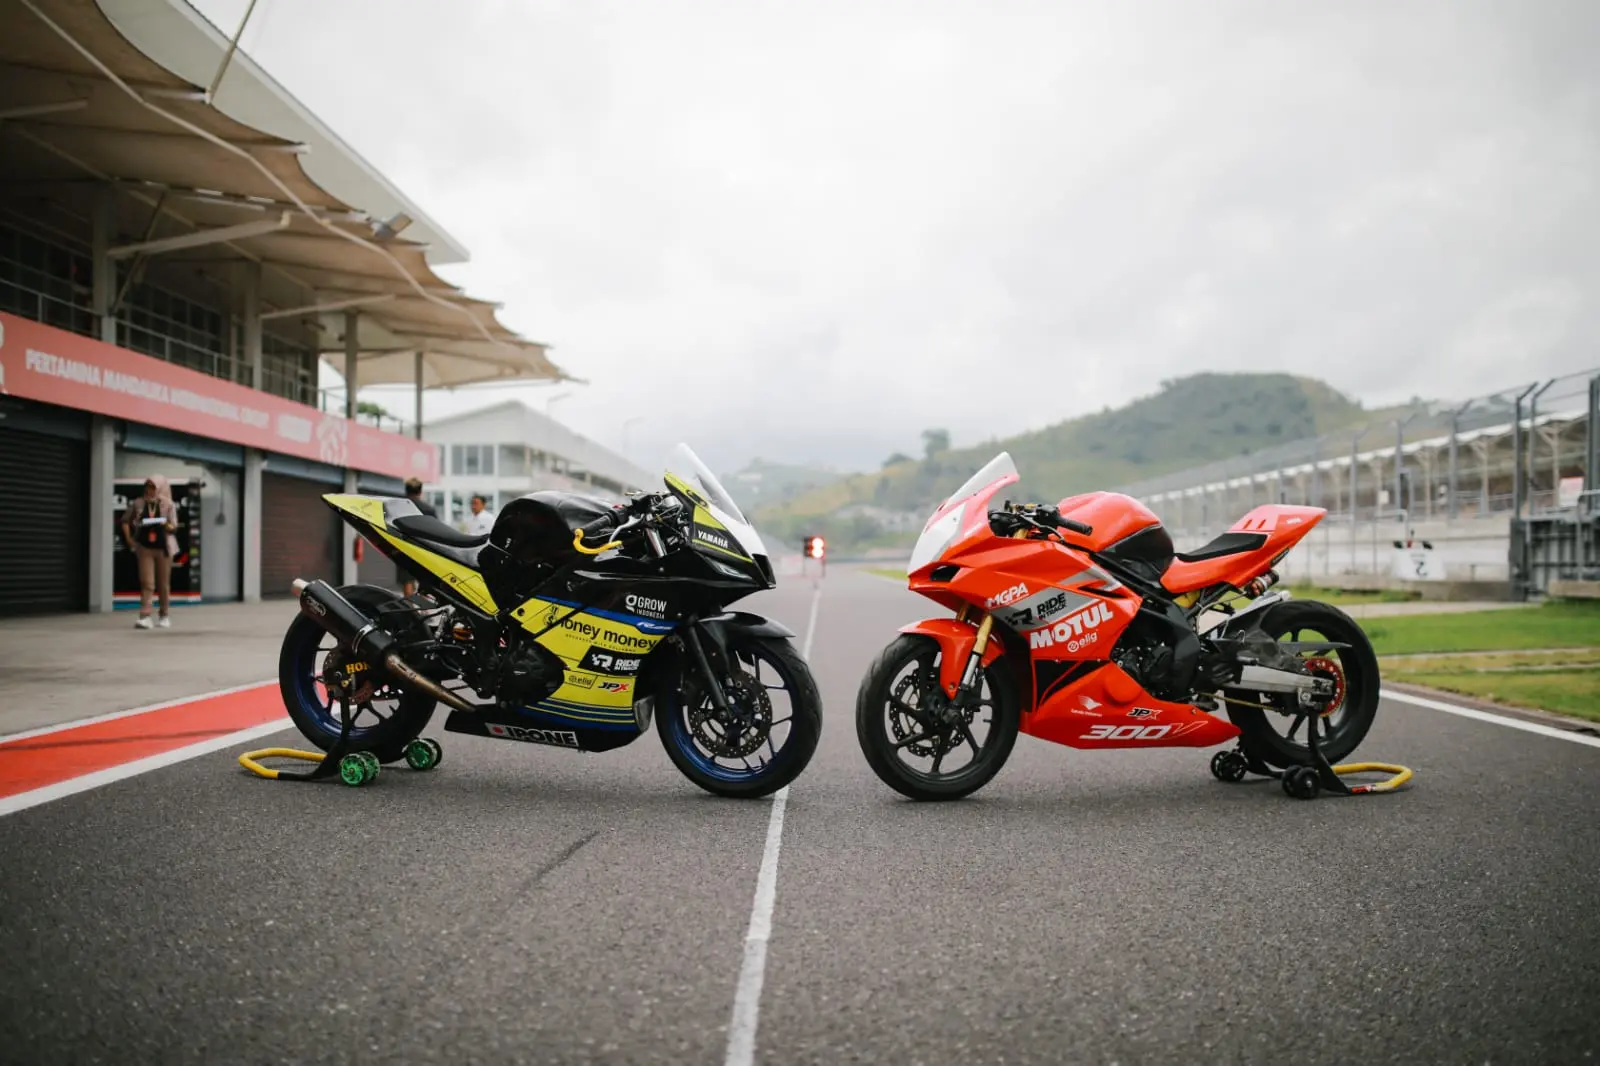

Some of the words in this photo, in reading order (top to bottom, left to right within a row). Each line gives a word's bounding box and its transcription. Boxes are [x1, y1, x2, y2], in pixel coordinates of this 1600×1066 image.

[697, 530, 728, 548] YAMAHA
[637, 596, 667, 613] GROW
[984, 582, 1029, 608] MGPA
[1036, 592, 1066, 617] RIDE
[636, 608, 665, 620] INDONESIA
[561, 617, 601, 641] oney
[1030, 600, 1114, 649] MOTUL
[597, 681, 630, 693] JPX
[1127, 707, 1162, 720] JPX
[504, 726, 578, 747] IPONE
